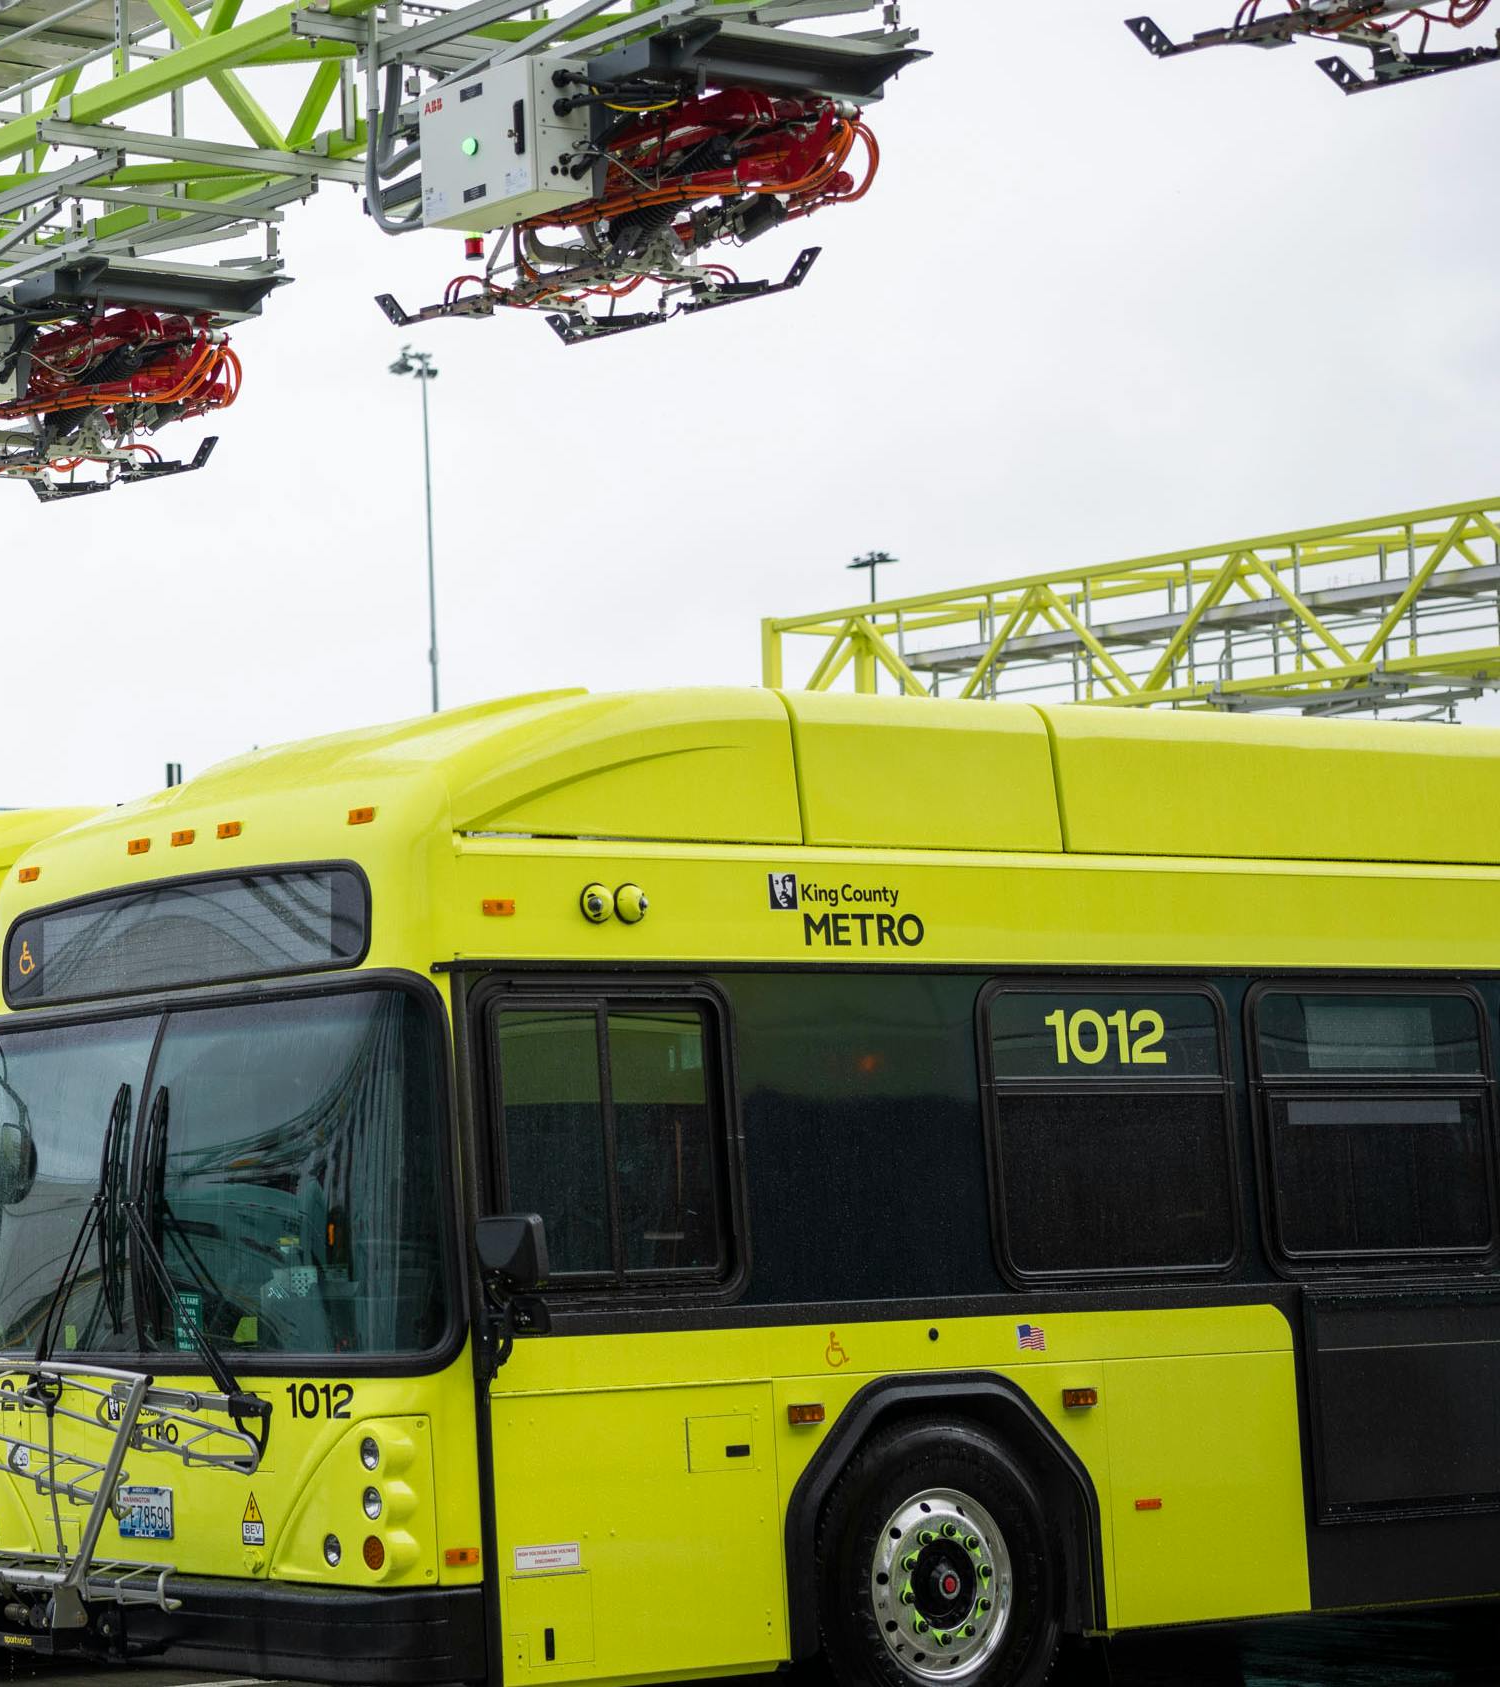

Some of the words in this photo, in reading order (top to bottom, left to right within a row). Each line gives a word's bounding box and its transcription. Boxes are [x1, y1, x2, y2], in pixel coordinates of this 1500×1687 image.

[424, 98, 443, 116] ABB
[801, 883, 839, 907] King
[841, 883, 899, 907] County
[803, 913, 924, 946] METRO
[1044, 1008, 1167, 1064] 1012
[286, 1383, 354, 1419] 1012
[244, 1524, 261, 1535] BEV
